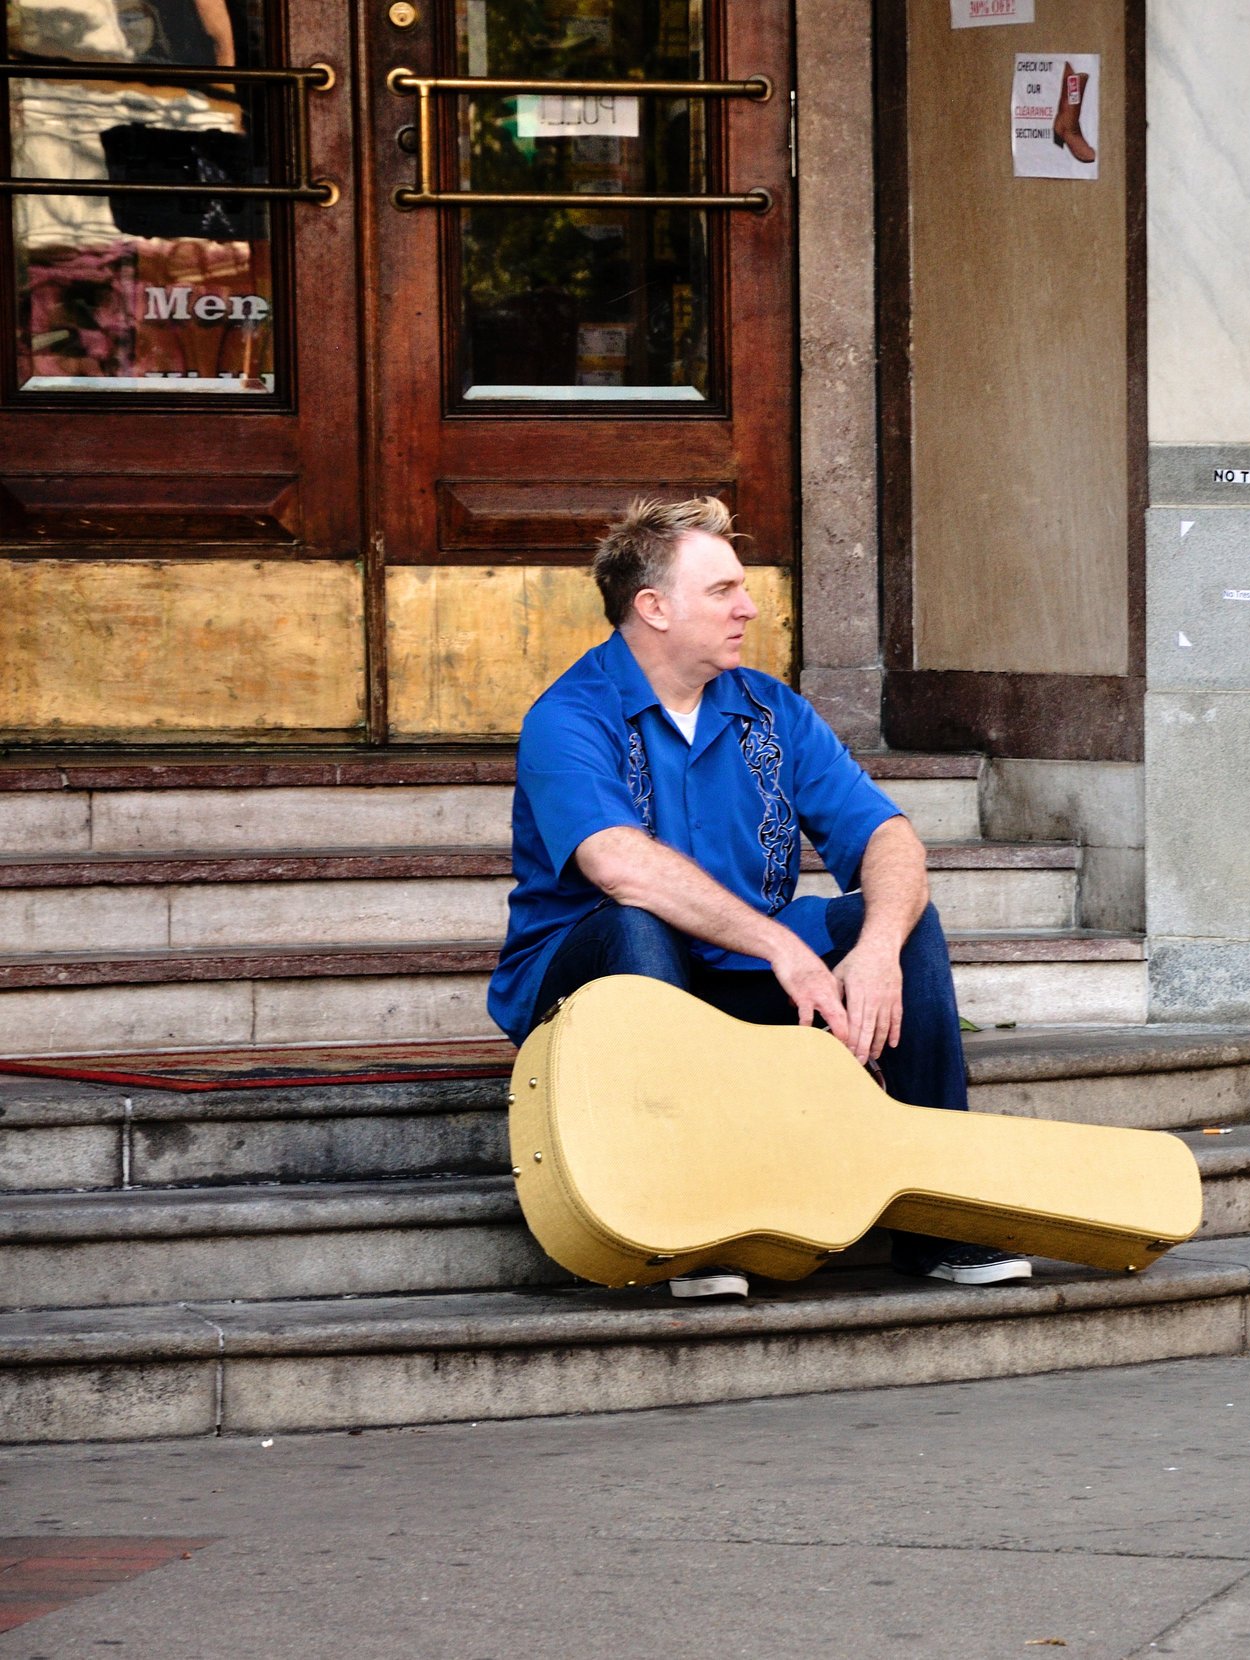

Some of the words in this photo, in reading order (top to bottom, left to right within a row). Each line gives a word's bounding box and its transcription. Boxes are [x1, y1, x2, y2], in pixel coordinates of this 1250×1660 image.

[1017, 61, 1037, 72] CHECK
[1039, 61, 1053, 72] OUT
[1026, 83, 1041, 94] OUR
[1015, 106, 1053, 118] CLEARANCE
[144, 286, 269, 321] Men
[1213, 469, 1235, 482] NO
